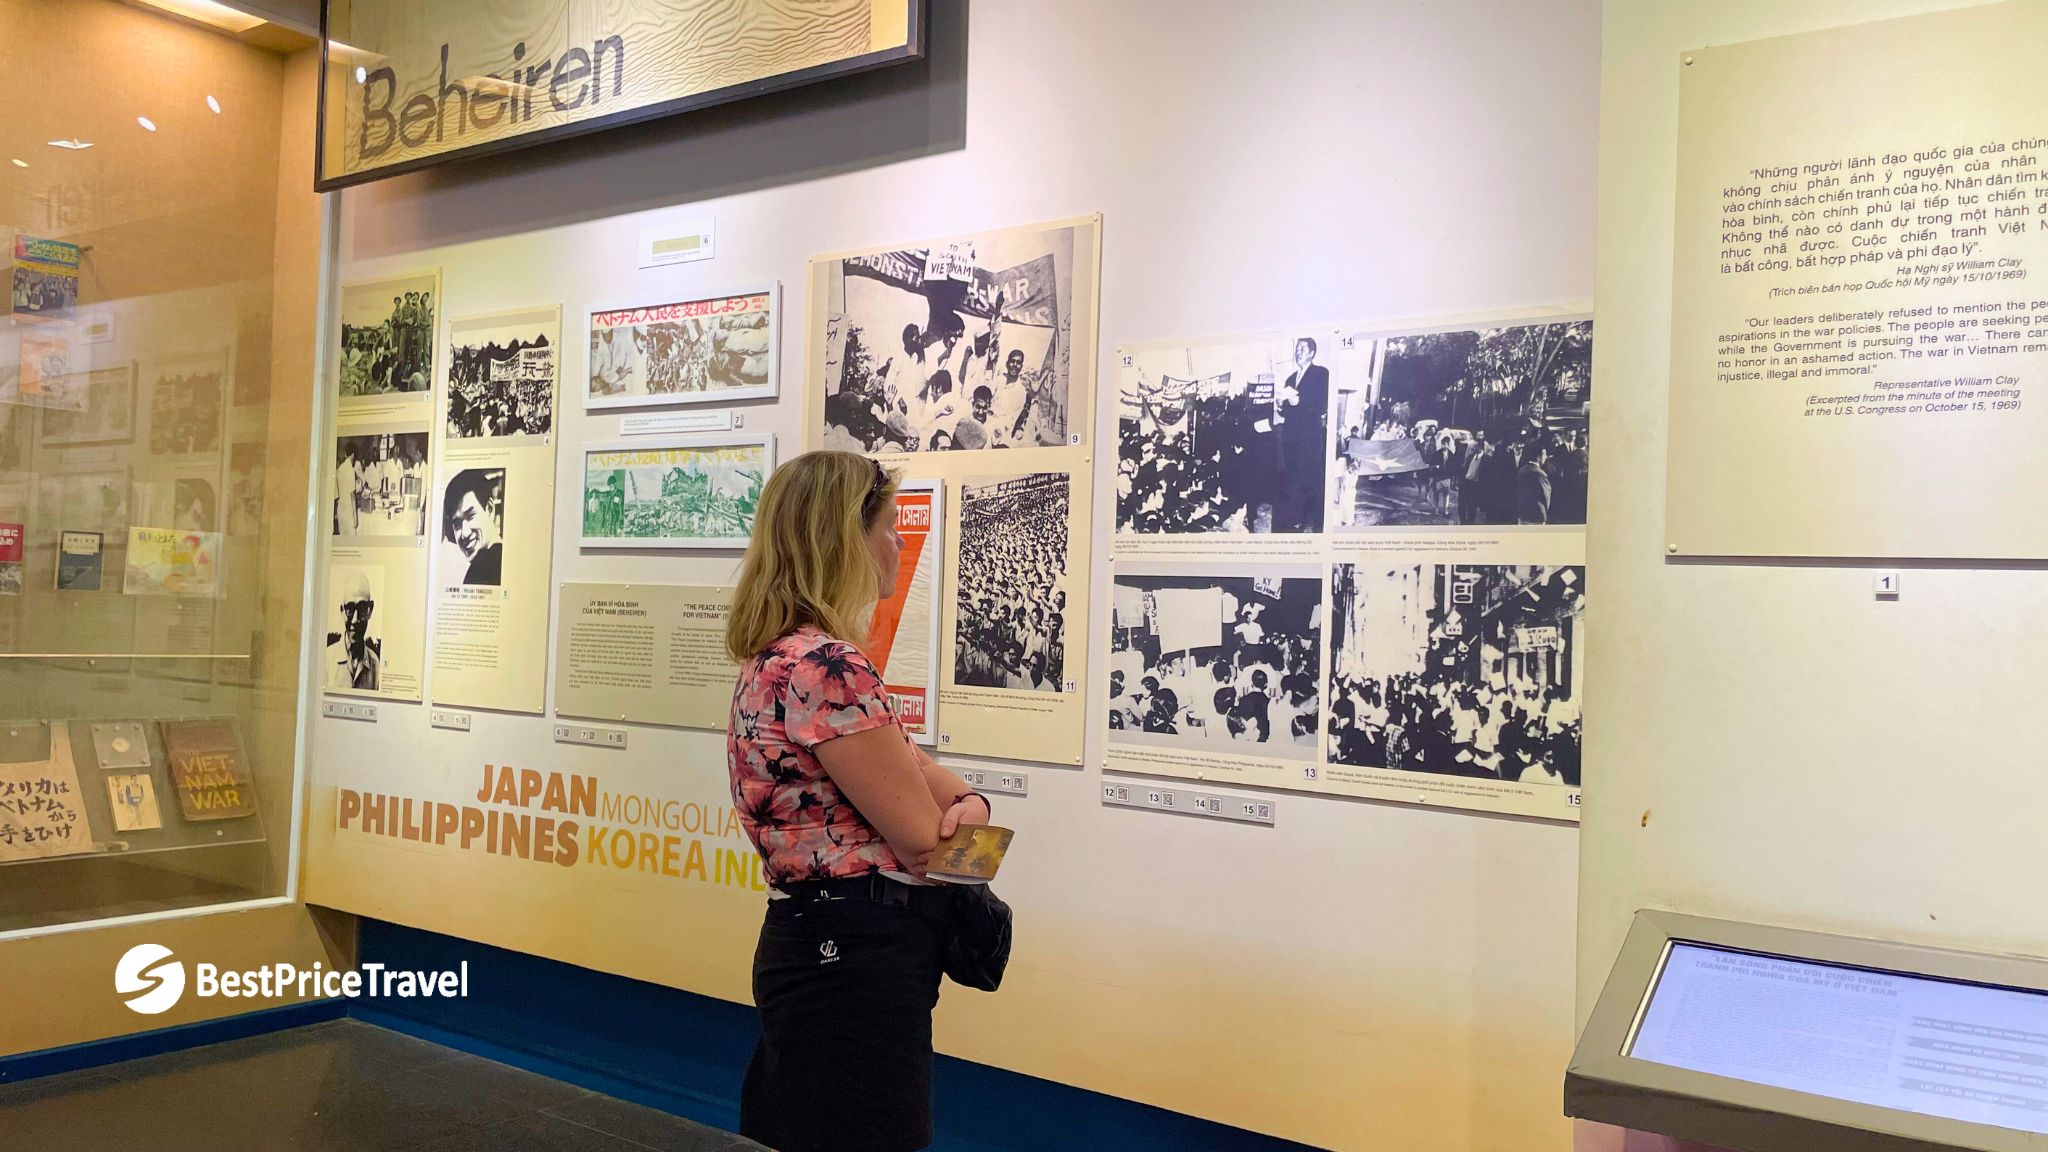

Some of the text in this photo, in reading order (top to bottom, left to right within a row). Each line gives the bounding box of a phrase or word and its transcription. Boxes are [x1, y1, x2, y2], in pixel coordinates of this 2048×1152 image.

[359, 35, 624, 161] Beheiren
[1804, 141, 2005, 175] người lãnh đạo quốc gia của
[1724, 155, 2037, 198] không chịu nguyện của nhân
[1723, 172, 2037, 213] vào chính sách chiến tranh của Nhân dân tìm
[1754, 188, 2026, 226] bình, còn chính lại tiếp tục chiến
[1722, 206, 2030, 244] Không thể nào có danh dự trong một hành
[1722, 222, 2026, 259] nhục nhã được. Cuộc chiến tranh Việt
[1735, 245, 1958, 273] bất công, bất hợp pháp và phi đạo
[1957, 258, 2023, 271] William Clay
[1933, 270, 2027, 286] ngày 15/10/1969)
[1774, 301, 2026, 326] leaders deliberately refused mention the
[1719, 315, 2030, 343] aspirations the war policies. The people are seeking
[1342, 337, 1353, 347] 14
[1718, 330, 2021, 355] while the Government pursuing the There
[1123, 356, 1132, 365] 12
[1718, 345, 2018, 368] no honor an ashamed action. The war Vietnam
[1717, 367, 1822, 383] injustice, illegal and
[1874, 376, 2020, 390] Representative William Clay
[1806, 389, 2020, 406] (Excerpted from the minute the meeting
[1816, 408, 1832, 416] the
[1834, 406, 1855, 416] U.S.
[1858, 406, 1907, 416] Congress
[1925, 402, 1969, 412] October
[1972, 402, 1986, 411] 15,
[1991, 400, 2021, 411] 1969)
[1072, 435, 1078, 443] 9
[1263, 578, 1272, 586] KY
[1882, 576, 1890, 589] 1
[1066, 682, 1074, 691] 11
[942, 735, 950, 743] 10
[965, 774, 1010, 786] 10 11
[1305, 768, 1316, 778] 13
[185, 774, 235, 790] NAM
[190, 791, 241, 810] WAR
[477, 764, 742, 839] JAPAN MONGOLIA
[1105, 789, 1254, 814] 12 13 14 15
[1568, 794, 1581, 805] 15
[48, 810, 77, 822] から
[340, 789, 579, 867] PHILIPPINES
[587, 827, 707, 882] KOREA
